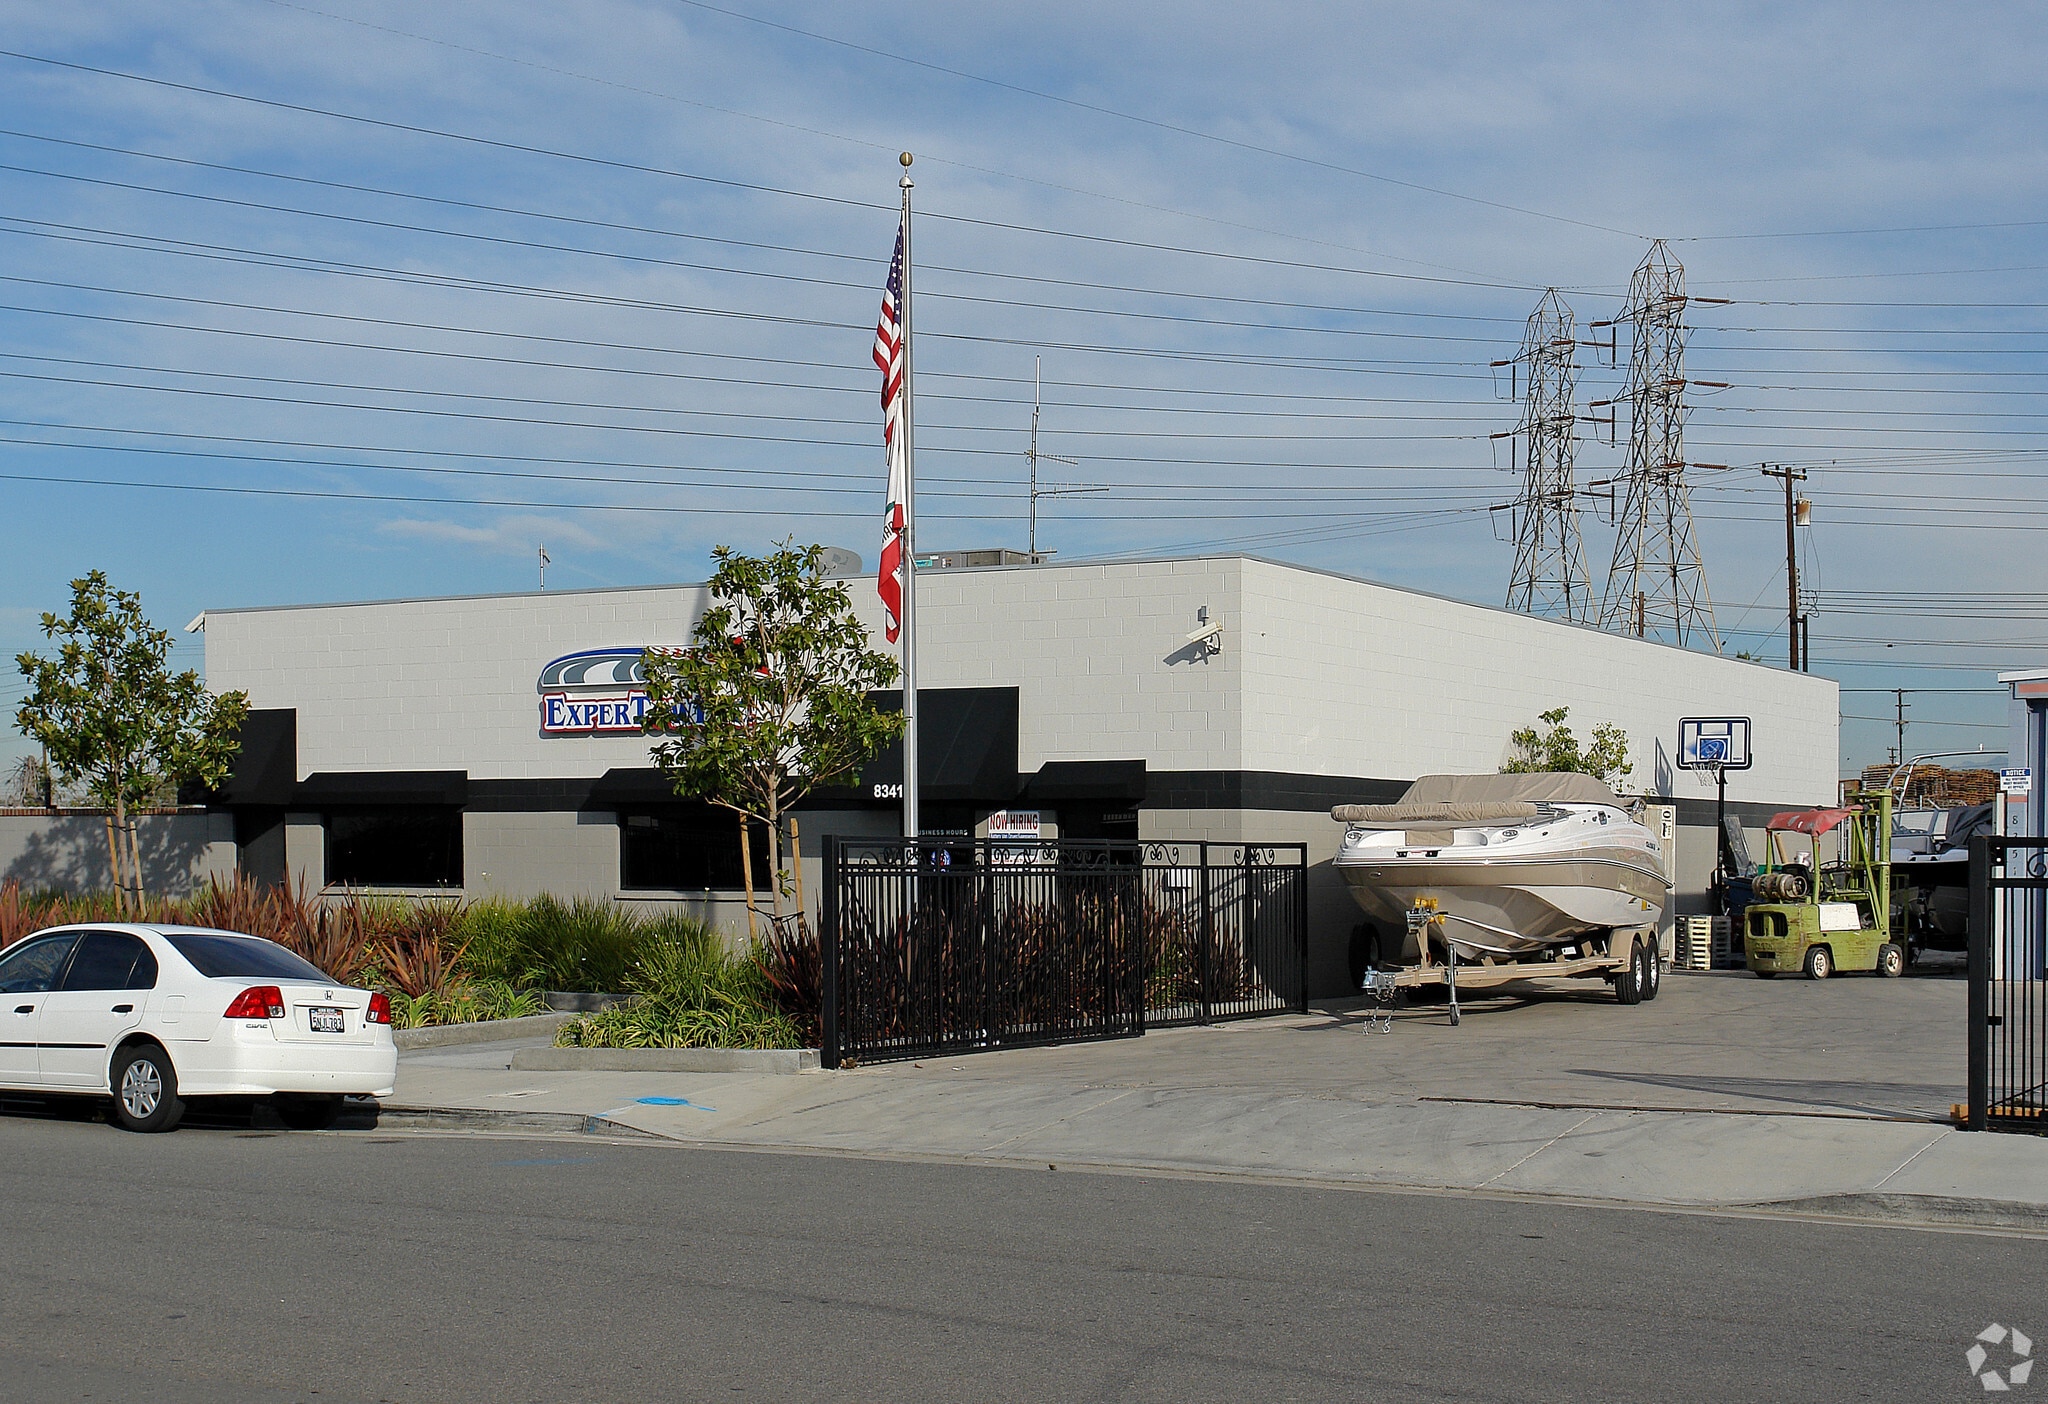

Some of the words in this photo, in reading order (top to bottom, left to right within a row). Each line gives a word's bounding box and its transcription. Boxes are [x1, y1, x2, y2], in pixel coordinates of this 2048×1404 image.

[873, 784, 903, 798] 8341
[990, 814, 1008, 830] NOW
[1010, 814, 1038, 830] HIRING
